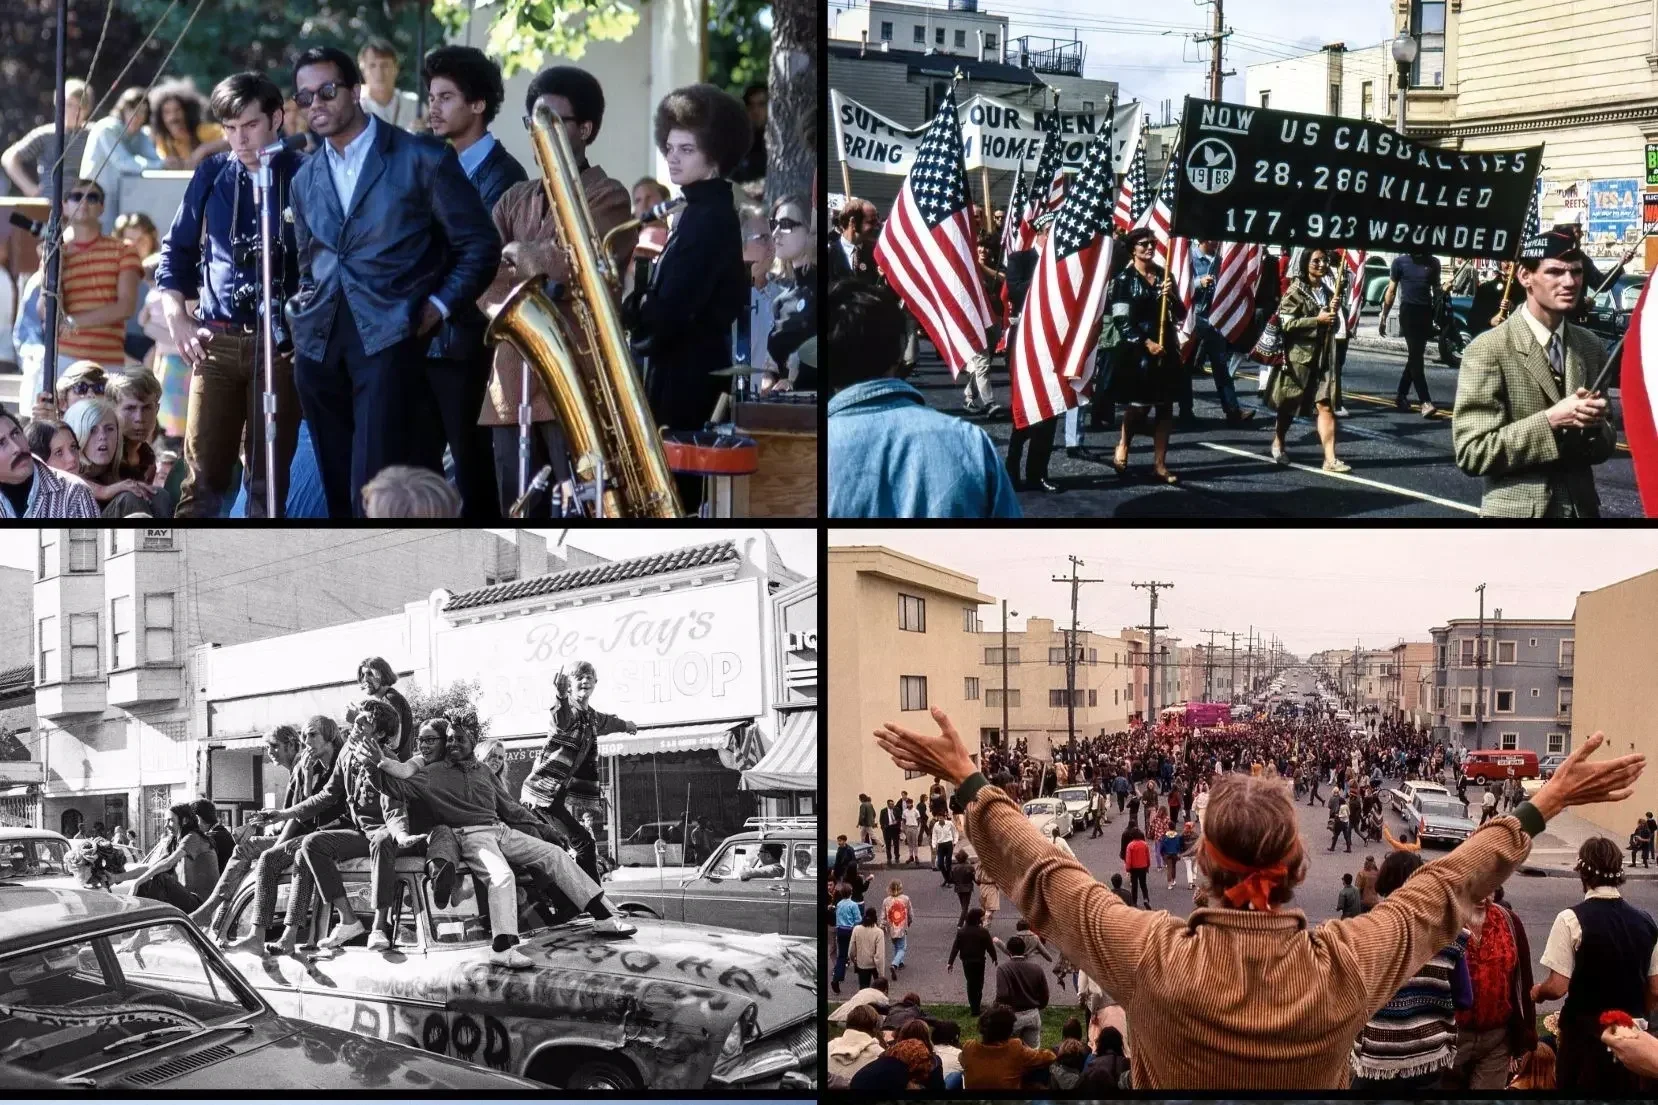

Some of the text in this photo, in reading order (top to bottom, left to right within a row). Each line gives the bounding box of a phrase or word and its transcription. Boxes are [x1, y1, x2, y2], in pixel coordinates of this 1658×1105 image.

[970, 104, 1021, 130] OUR
[1201, 104, 1255, 130] NOW
[843, 132, 903, 164] BRING
[981, 134, 1041, 161] HOME
[1280, 119, 1526, 174] US CASUALTIES
[1254, 159, 1493, 209] 28,286 KILLED
[1226, 207, 1508, 252] 177,923 WOUNDED
[147, 529, 168, 537] RAY
[523, 609, 716, 663] Be-Jay's
[612, 651, 742, 704] SHOP
